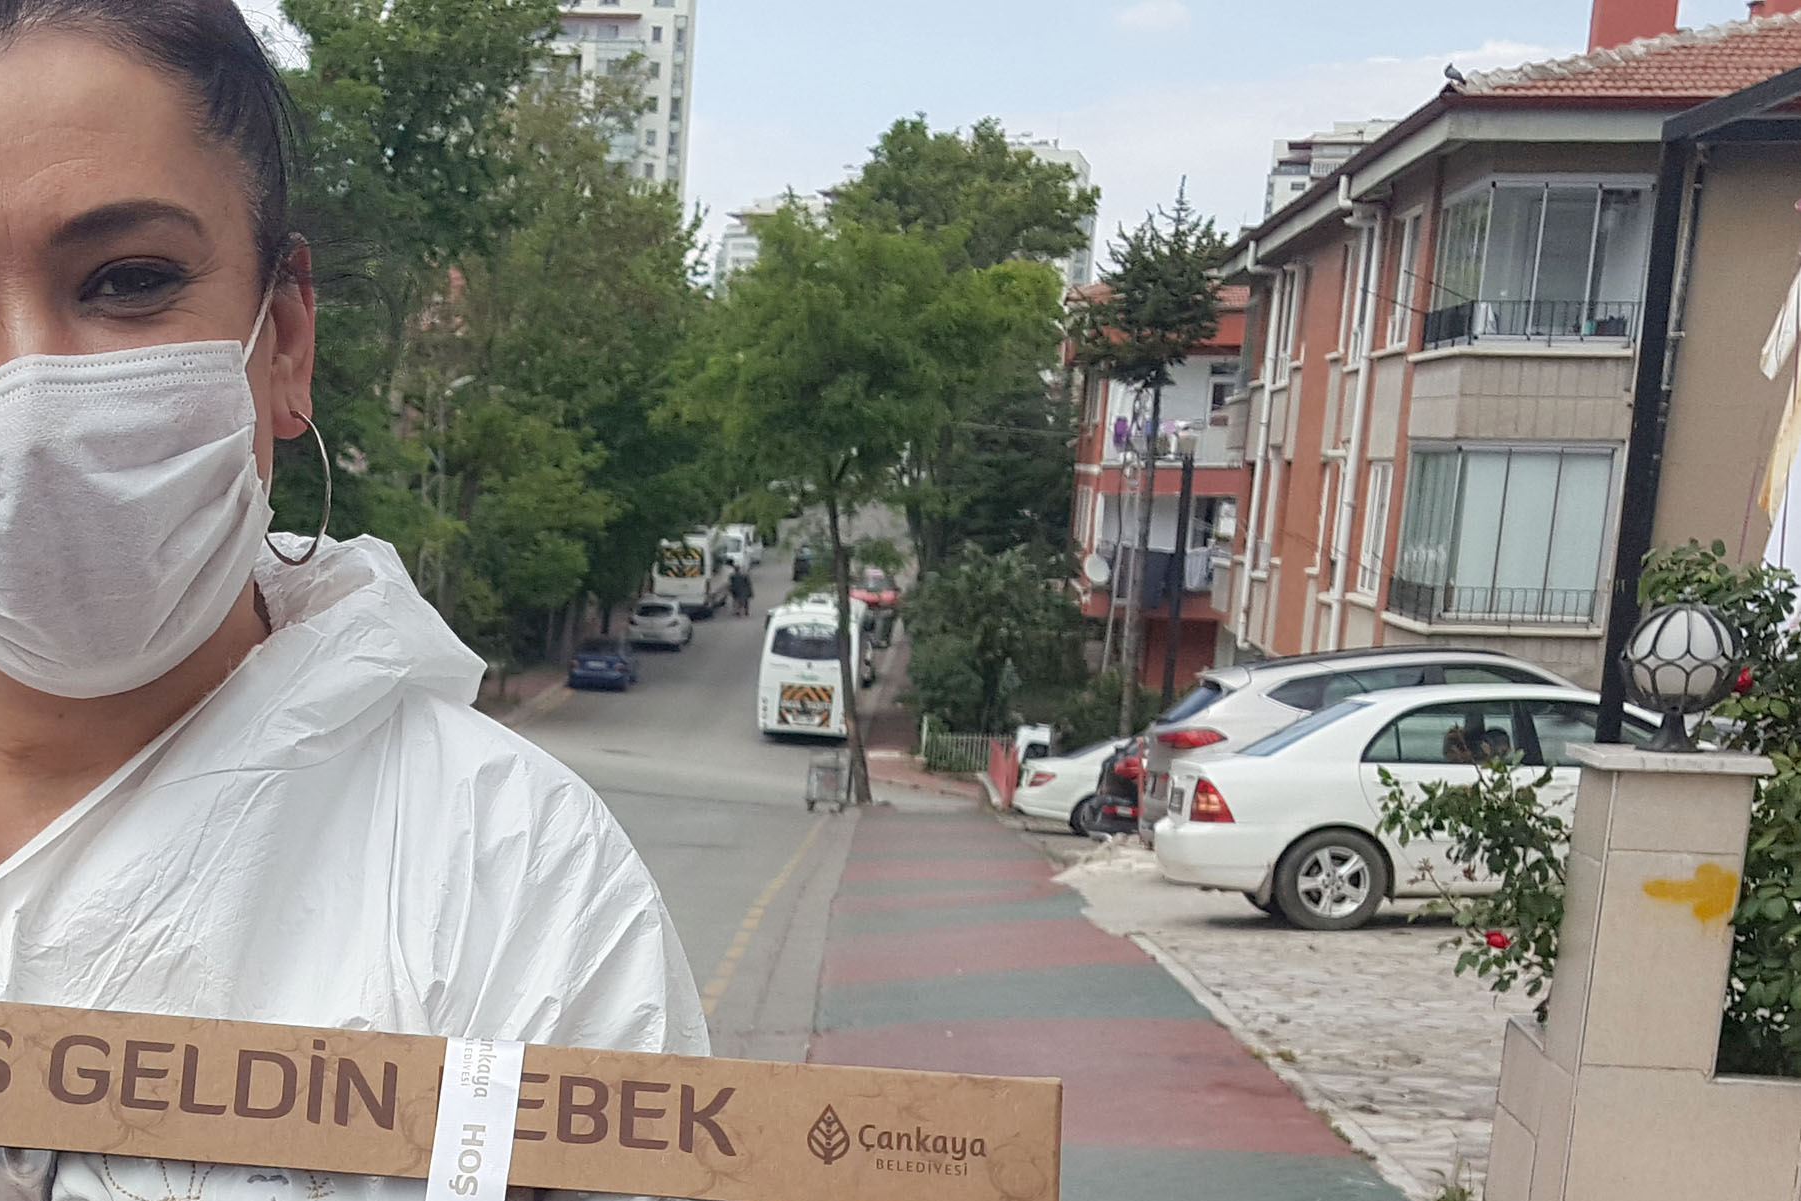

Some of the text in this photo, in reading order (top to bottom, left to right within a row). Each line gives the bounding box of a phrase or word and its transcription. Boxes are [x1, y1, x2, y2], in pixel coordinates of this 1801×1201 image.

[48, 1034, 399, 1131] GELDİN
[438, 1066, 738, 1158] EBEK
[471, 1038, 497, 1098] nkaya
[449, 1123, 487, 1197] HOŞ
[858, 1124, 987, 1161] Çankaya
[875, 1158, 968, 1176] BELEDİYESİ
